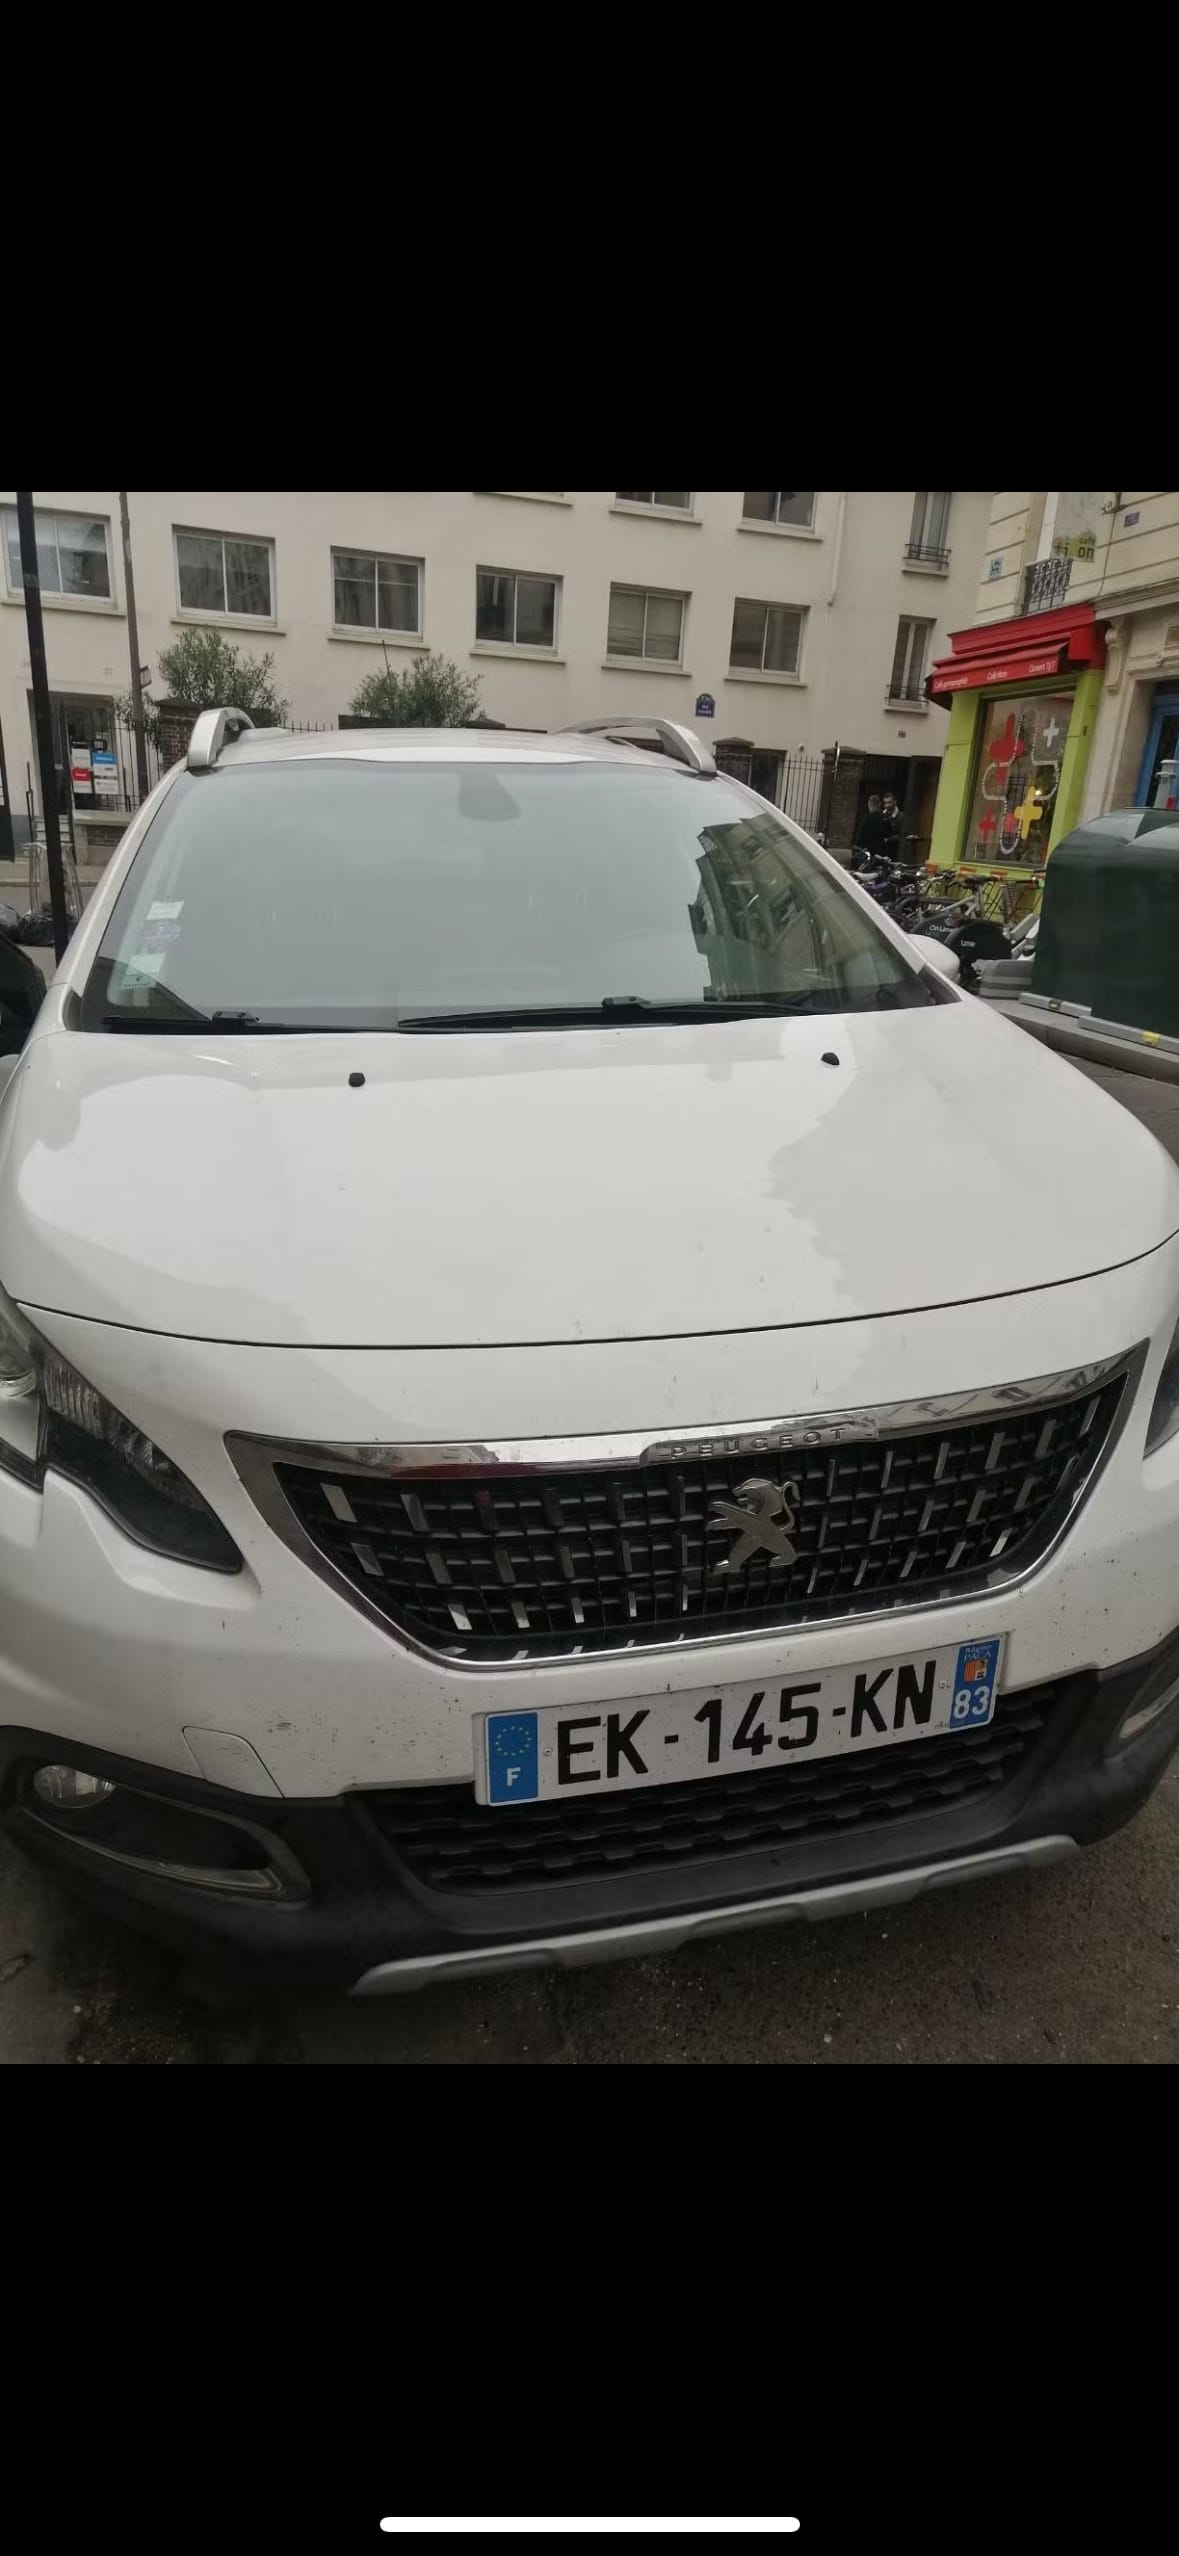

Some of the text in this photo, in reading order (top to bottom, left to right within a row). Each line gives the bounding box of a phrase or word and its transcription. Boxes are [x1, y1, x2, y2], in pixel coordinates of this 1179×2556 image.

[960, 939, 976, 948] Lime
[671, 1427, 846, 1459] PEUGEOT
[953, 1686, 990, 1720] 83
[505, 1766, 521, 1787] F
